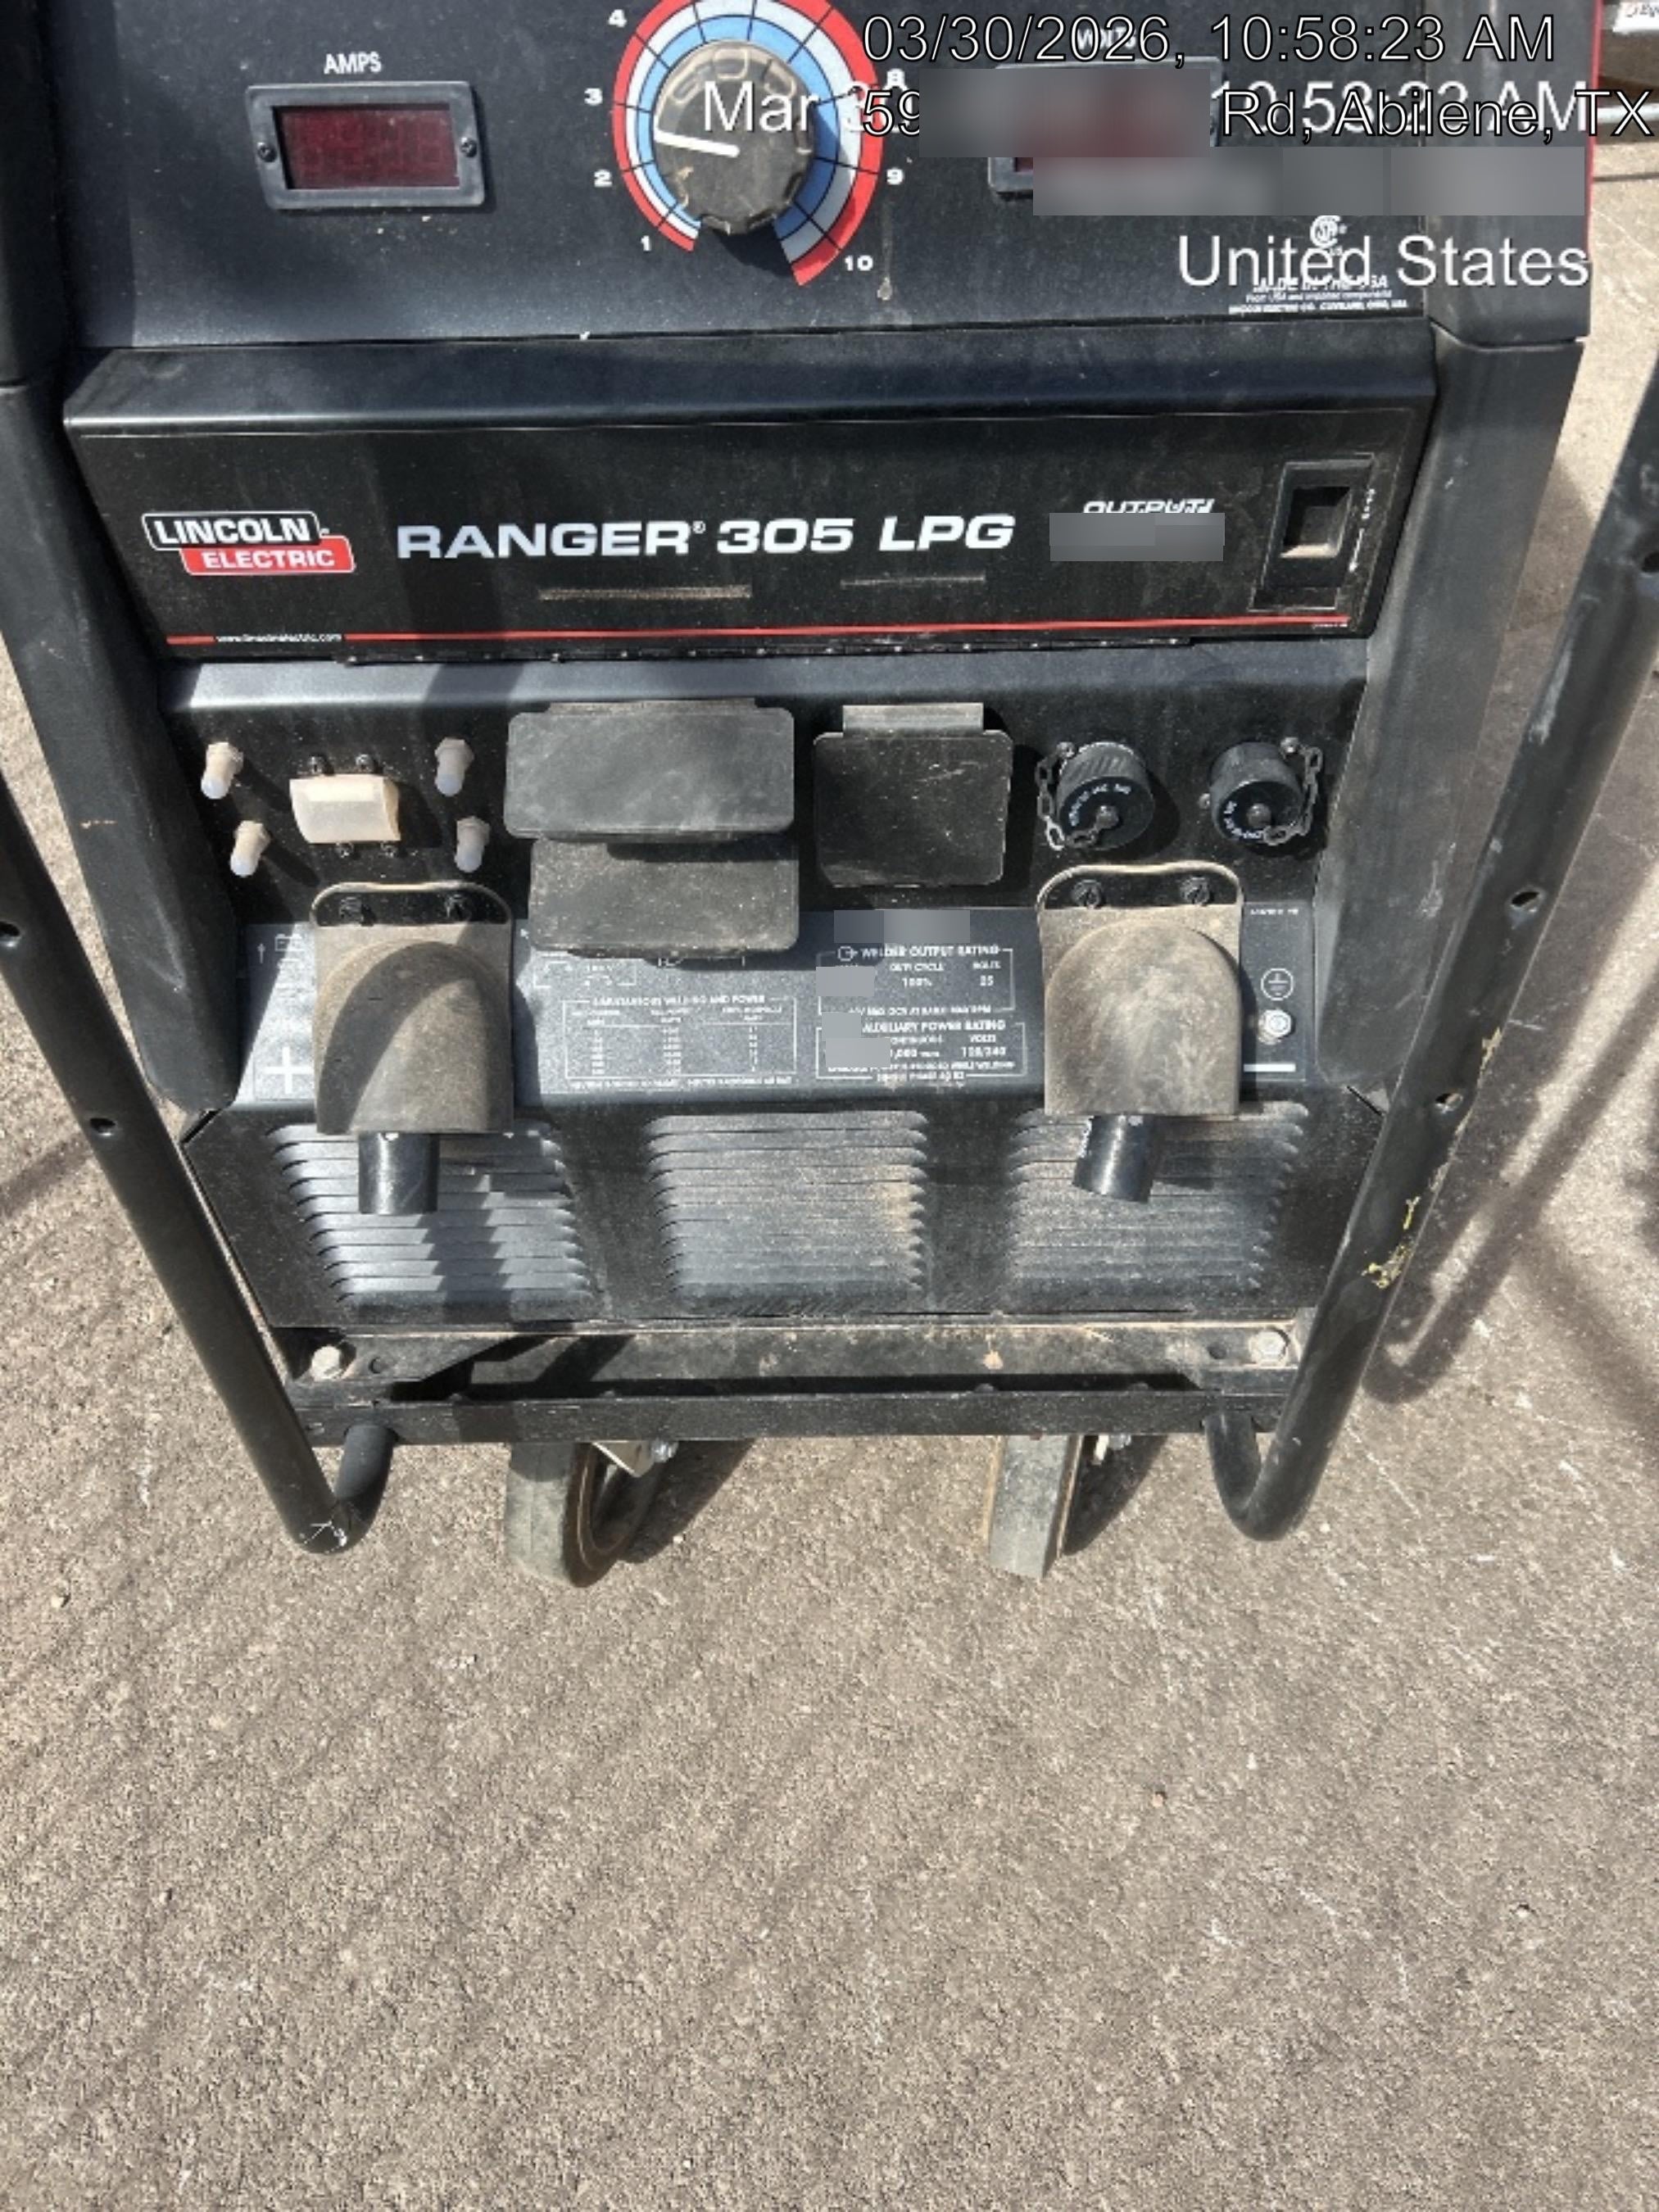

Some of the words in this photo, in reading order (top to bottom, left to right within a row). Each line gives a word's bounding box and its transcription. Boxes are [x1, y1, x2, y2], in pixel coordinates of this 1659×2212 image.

[608, 9, 627, 28] 4
[324, 52, 382, 74] AMPS
[585, 88, 603, 105] 3
[594, 170, 612, 188] 2
[886, 170, 904, 184] 9
[640, 236, 652, 251] 1
[845, 255, 873, 271] 10
[154, 517, 312, 544] LINCOLN
[716, 518, 854, 555] 305
[878, 513, 1017, 552] LPG
[202, 550, 335, 569] ELECTRIC
